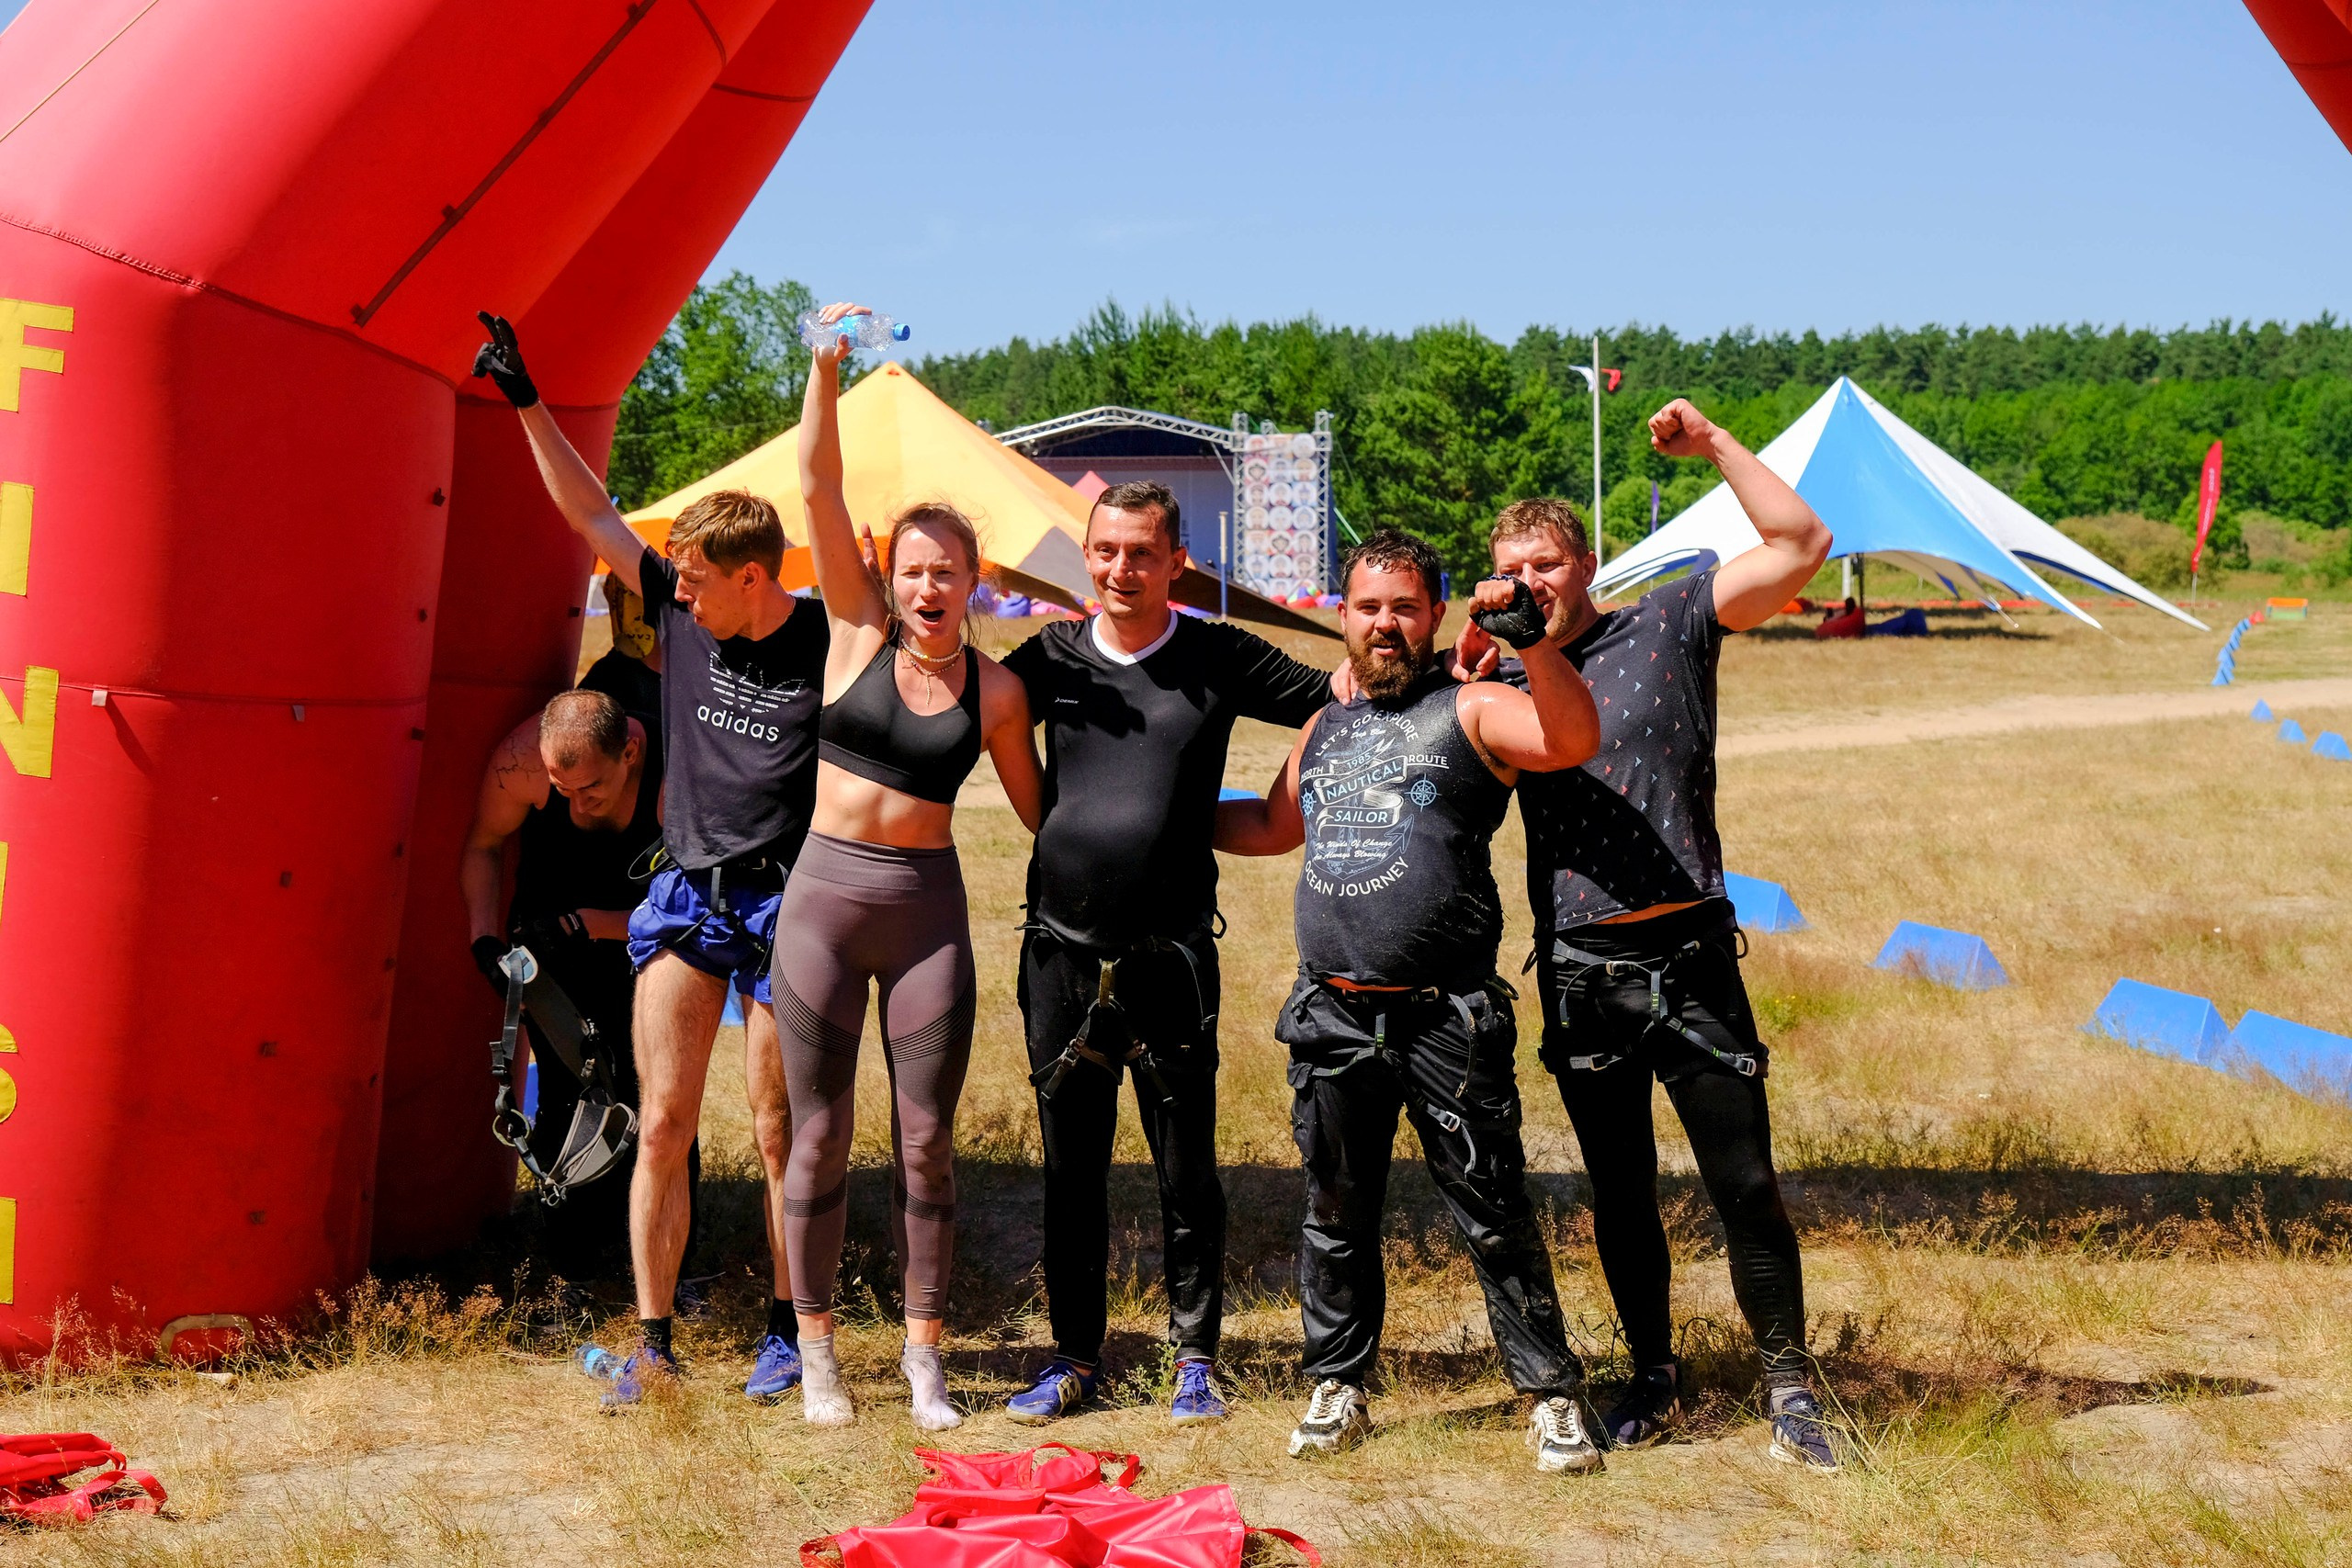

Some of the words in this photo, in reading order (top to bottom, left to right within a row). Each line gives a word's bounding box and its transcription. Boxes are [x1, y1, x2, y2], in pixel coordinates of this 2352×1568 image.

[697, 705, 779, 741] adidas
[1315, 727, 1349, 756] LET'S
[1351, 714, 1372, 728] GO
[1374, 709, 1419, 742] EXPLORE
[1301, 766, 1324, 781] NORTH
[1409, 754, 1448, 765] ROUTE
[1347, 753, 1371, 769] 1985
[1326, 761, 1402, 800] NAUTICAL
[1334, 810, 1388, 823] SAILOR
[1353, 850, 1387, 860] Blowing
[1363, 838, 1394, 848] Change
[1305, 860, 1334, 896] OCEAN
[1338, 856, 1408, 897] JOURNEY
